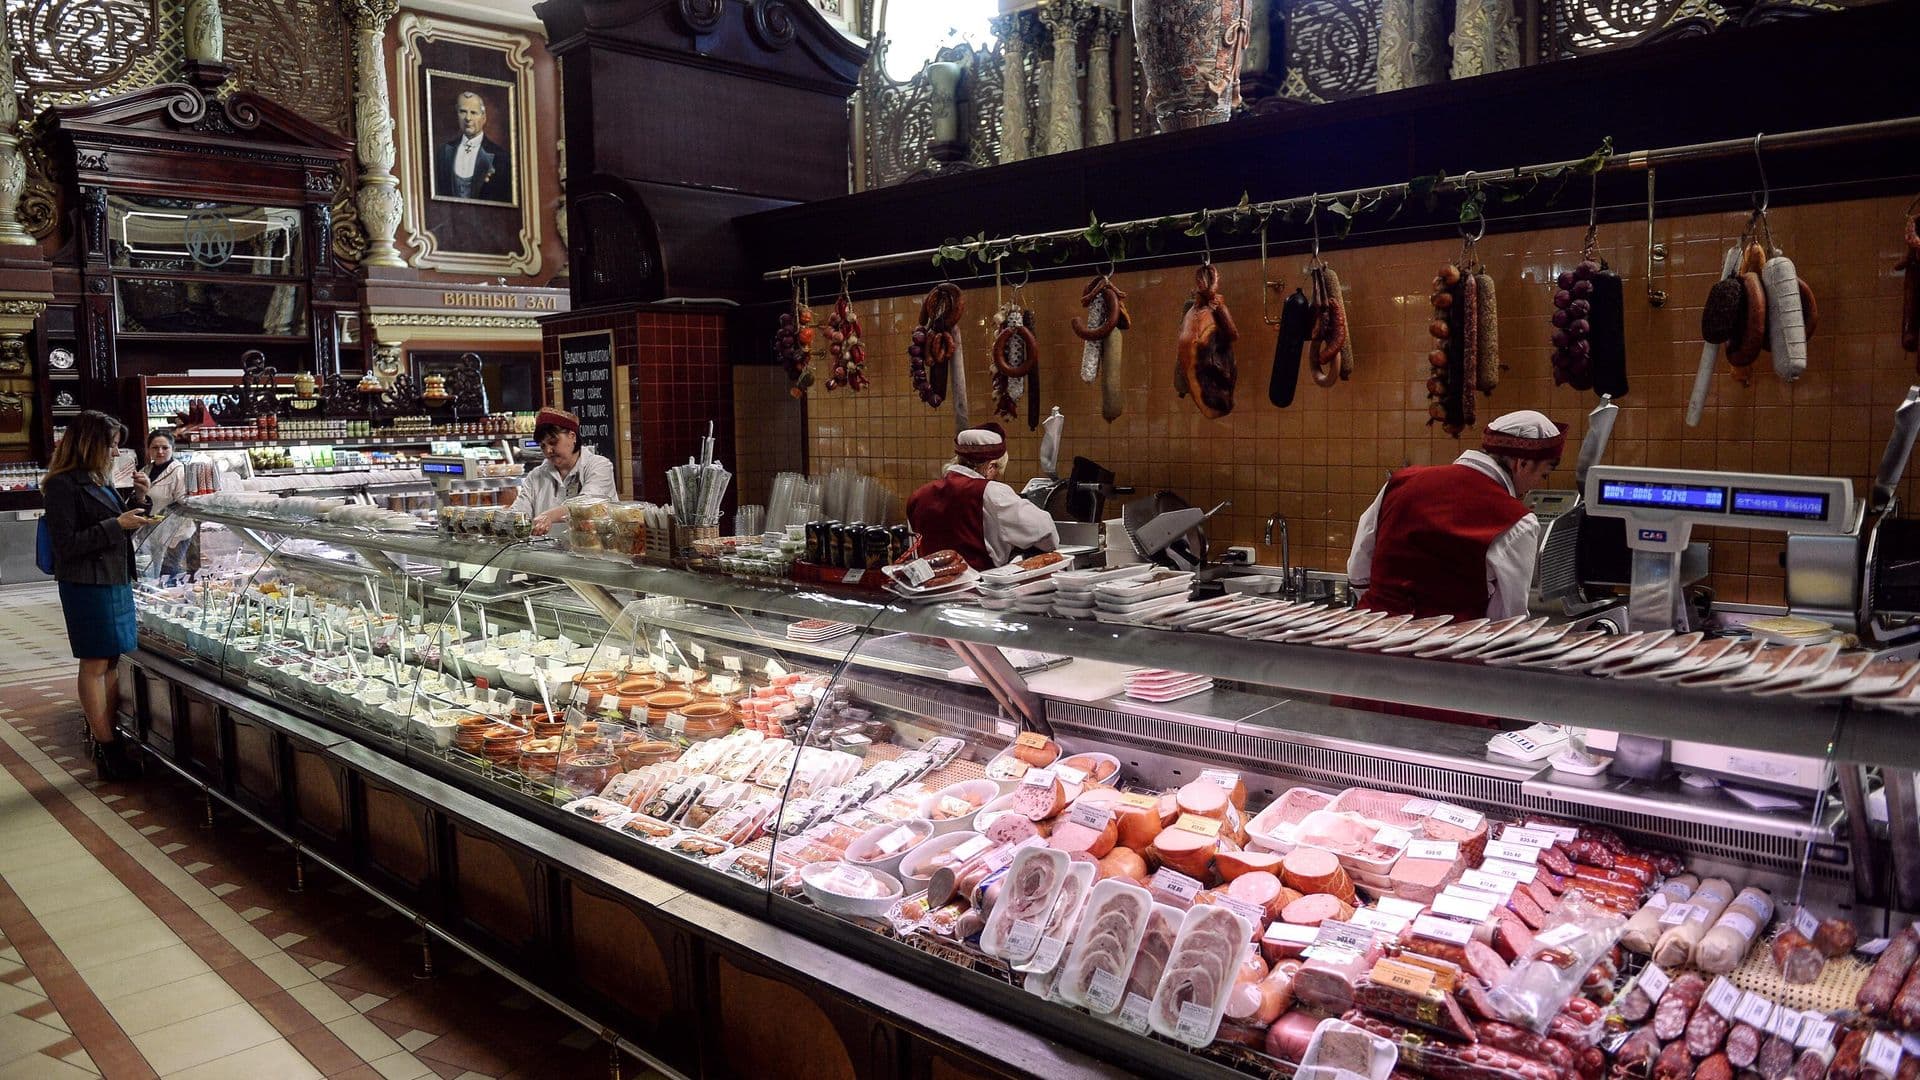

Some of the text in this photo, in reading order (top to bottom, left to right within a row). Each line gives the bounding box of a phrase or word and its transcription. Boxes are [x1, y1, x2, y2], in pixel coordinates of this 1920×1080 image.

[443, 292, 557, 310] ВИННЫЙ ЗАЛ
[1641, 531, 1665, 541] CAS
